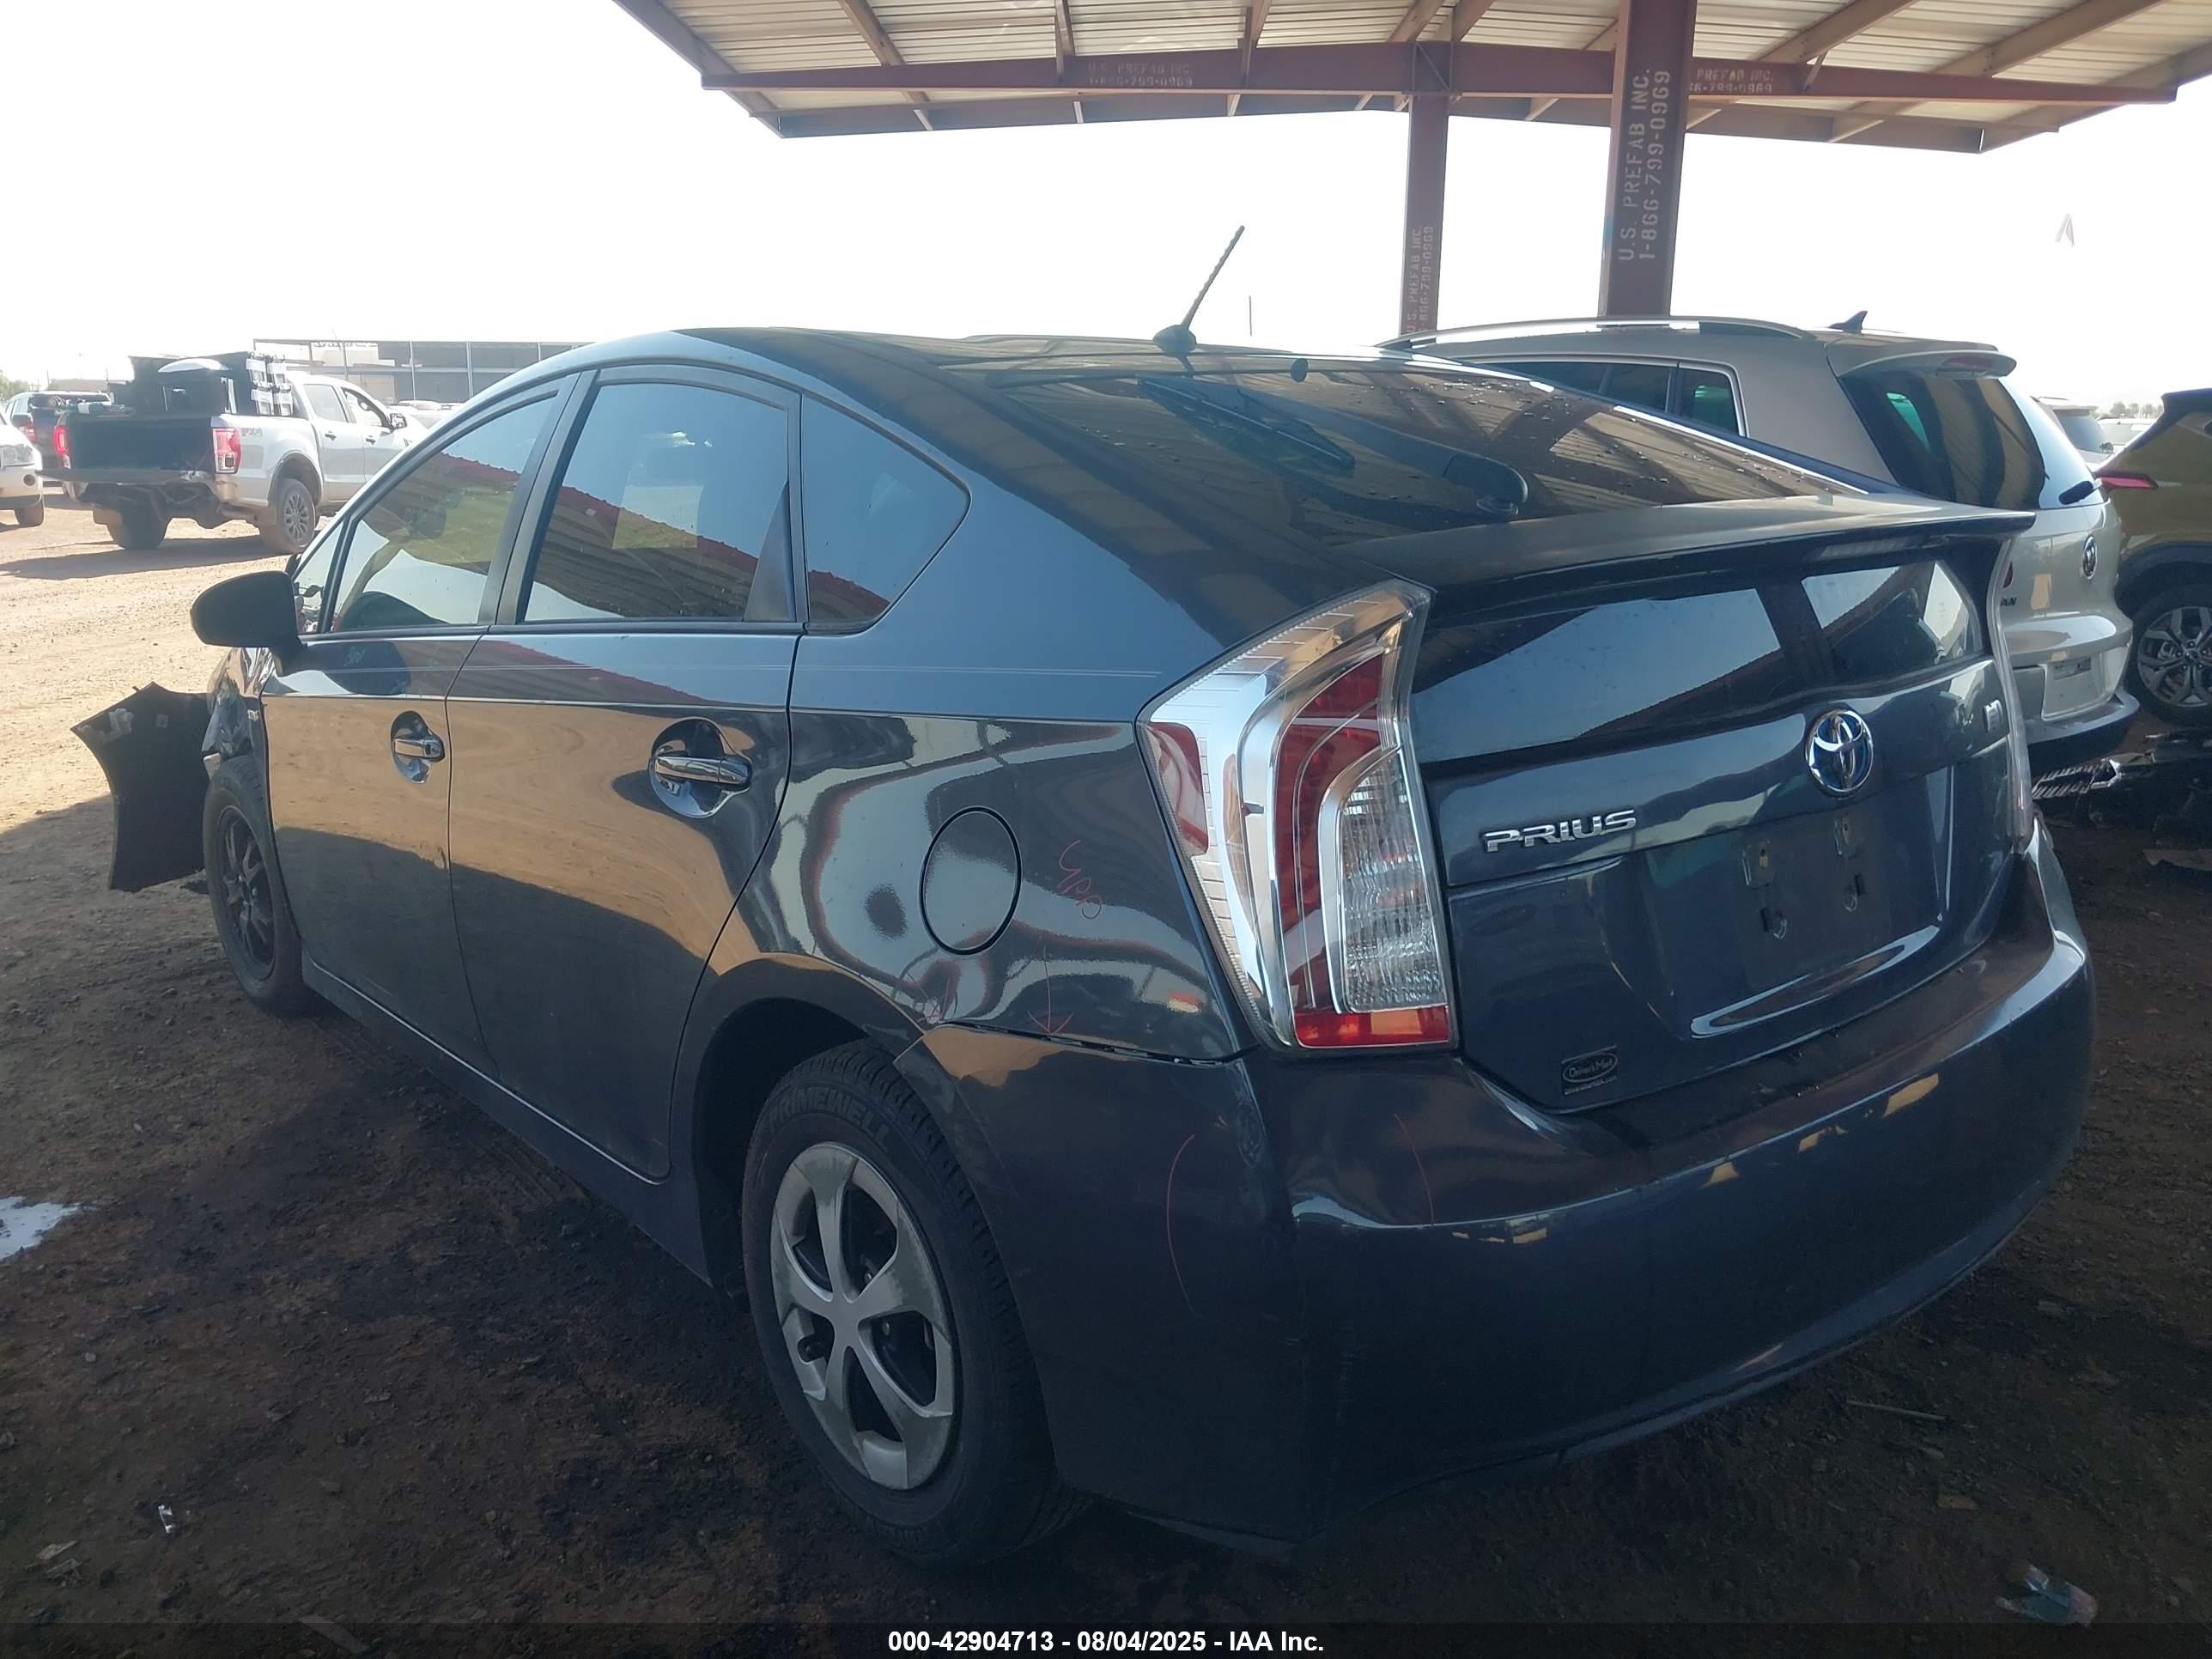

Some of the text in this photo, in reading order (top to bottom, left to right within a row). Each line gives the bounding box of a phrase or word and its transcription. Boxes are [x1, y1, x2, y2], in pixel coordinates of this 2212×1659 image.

[1697, 69, 1745, 82] PREFAB
[1617, 69, 1651, 261] U.S. PREFAB INC.
[1638, 70, 1670, 259] 1-866-799-0969
[1408, 255, 1419, 303] PREFAB
[1484, 809, 1638, 853] PRIUS
[767, 1086, 891, 1154] PRIMEWELL
